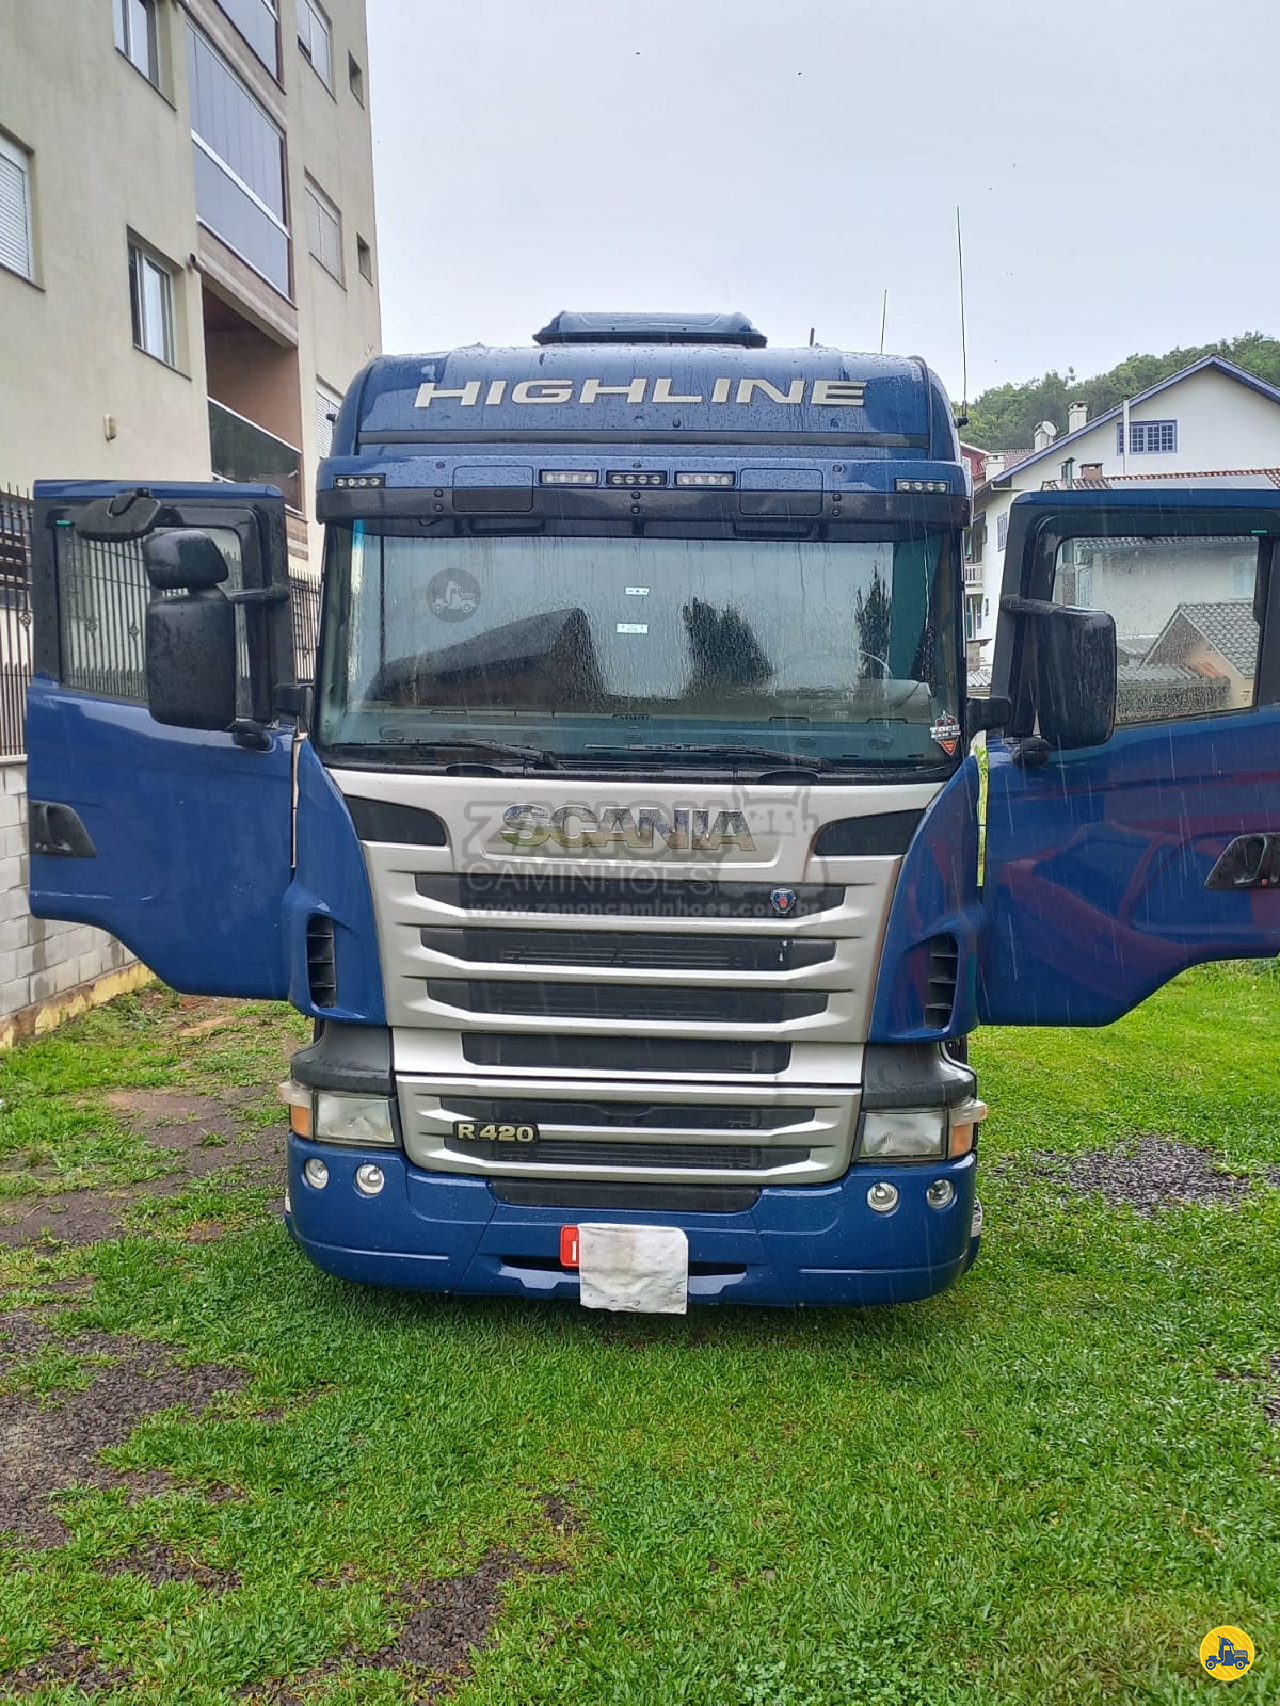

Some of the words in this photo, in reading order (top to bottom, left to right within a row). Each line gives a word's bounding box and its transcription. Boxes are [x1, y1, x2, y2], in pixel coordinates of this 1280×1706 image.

[414, 377, 867, 408] HIGHLINE
[500, 803, 757, 852] SCANIA
[458, 1123, 476, 1140] R
[479, 1124, 534, 1142] 420
